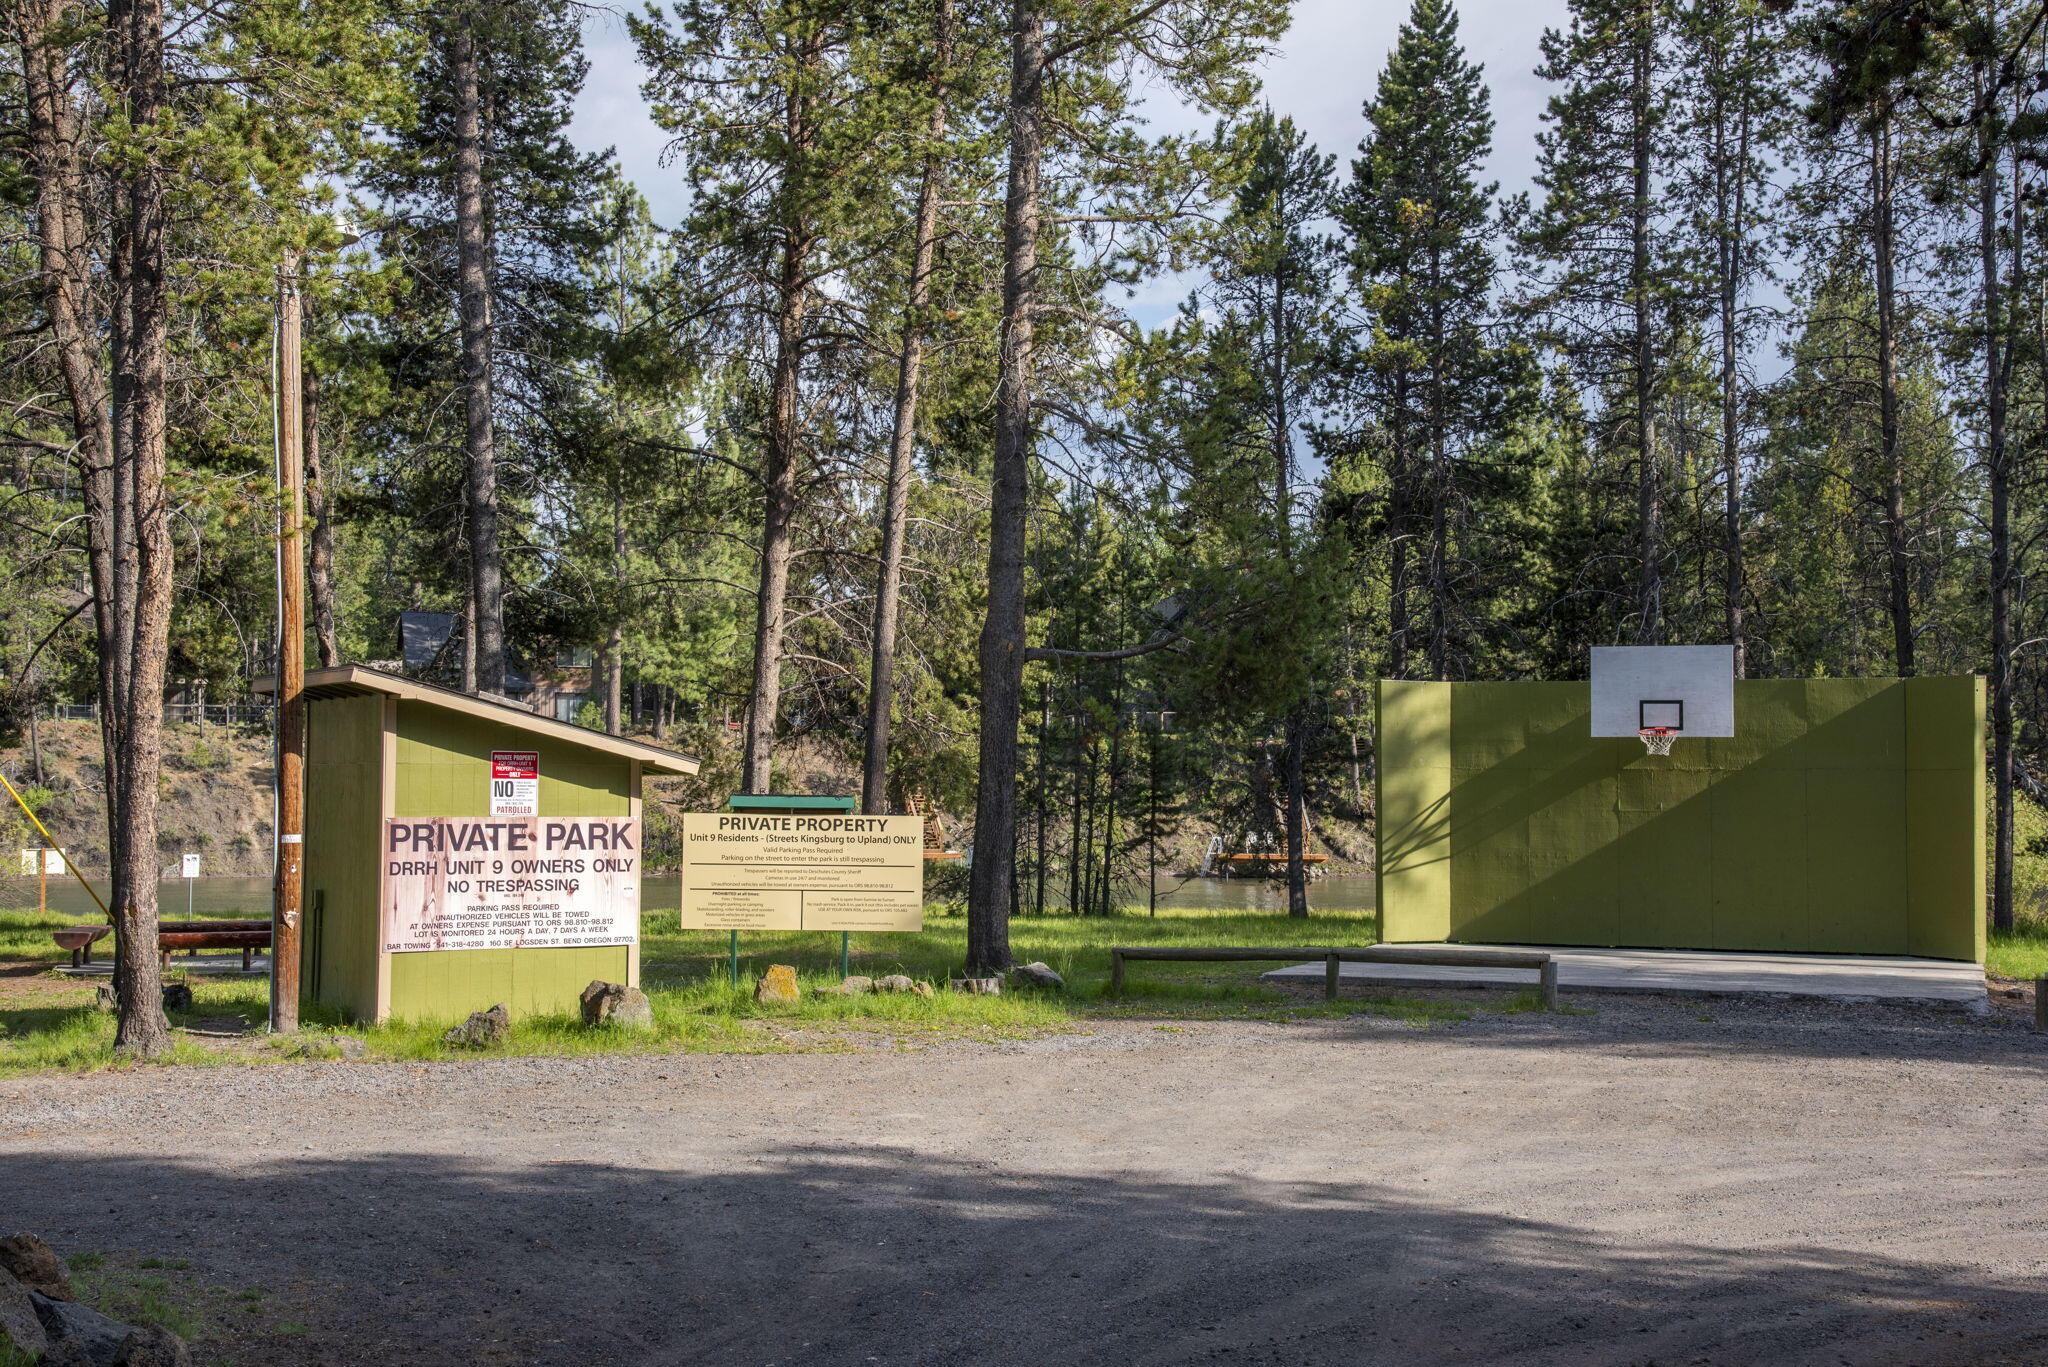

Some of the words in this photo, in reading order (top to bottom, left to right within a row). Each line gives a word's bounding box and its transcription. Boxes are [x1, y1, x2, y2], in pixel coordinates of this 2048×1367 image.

[494, 780, 514, 797] NO
[719, 817, 791, 831] PRIVATE
[796, 818, 888, 832] PROPERTY
[390, 823, 528, 853] PRIVATE
[545, 822, 634, 851] PARK
[690, 833, 708, 842] Unit
[710, 833, 716, 842] 9
[717, 833, 759, 842] Residents
[766, 834, 799, 843] (Streets
[800, 834, 844, 845] Kingsburg
[847, 836, 855, 844] to
[857, 835, 891, 845] Upland)
[893, 835, 917, 844] ONLY
[816, 847, 844, 855] Required
[721, 854, 744, 862] Parking
[819, 855, 833, 864] park
[851, 856, 885, 864] trespassing
[389, 861, 438, 876] DRRH
[446, 860, 485, 875] UNIT
[492, 859, 504, 874] 9
[511, 859, 585, 874] OWNERS
[593, 858, 634, 873] ONLY
[447, 880, 470, 893] NO
[476, 878, 579, 893] TRESPASSING
[522, 903, 560, 911] REQUIRED
[435, 913, 492, 921] UNAUTHORIZED
[495, 912, 530, 920] VEHICLES
[533, 911, 550, 919] WILL
[421, 922, 454, 930] OWNERS
[456, 921, 490, 929] EXPENSE
[492, 920, 531, 928] PURSUANT
[534, 919, 543, 927] TO
[564, 918, 614, 926] 98.810-98.812
[441, 929, 485, 937] MONITORED
[499, 928, 525, 936] HOURS
[436, 940, 484, 948] 541-318-4280
[515, 938, 548, 946] LOGSDEN
